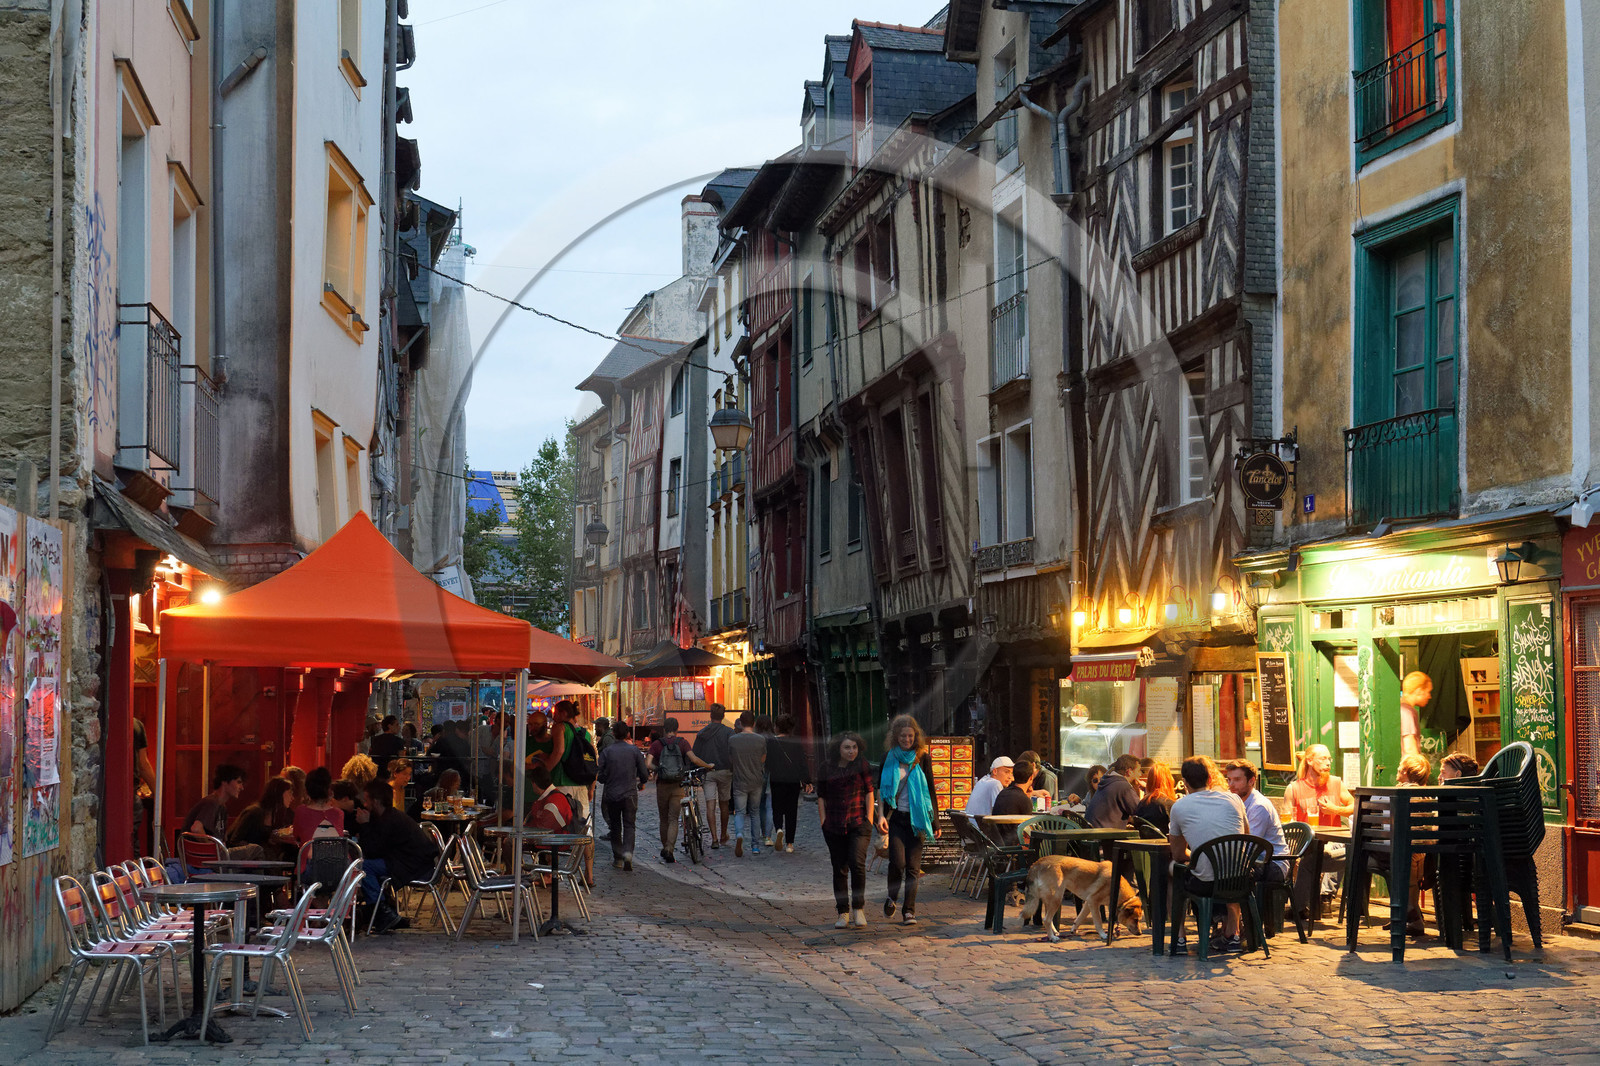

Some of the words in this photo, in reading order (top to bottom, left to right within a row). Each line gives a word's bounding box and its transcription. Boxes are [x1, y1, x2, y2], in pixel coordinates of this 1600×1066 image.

[1305, 497, 1311, 511] 4
[1586, 556, 1600, 580] G
[1076, 665, 1098, 679] PALAIS
[1099, 664, 1109, 677] DU
[1109, 663, 1132, 678] KEBAB
